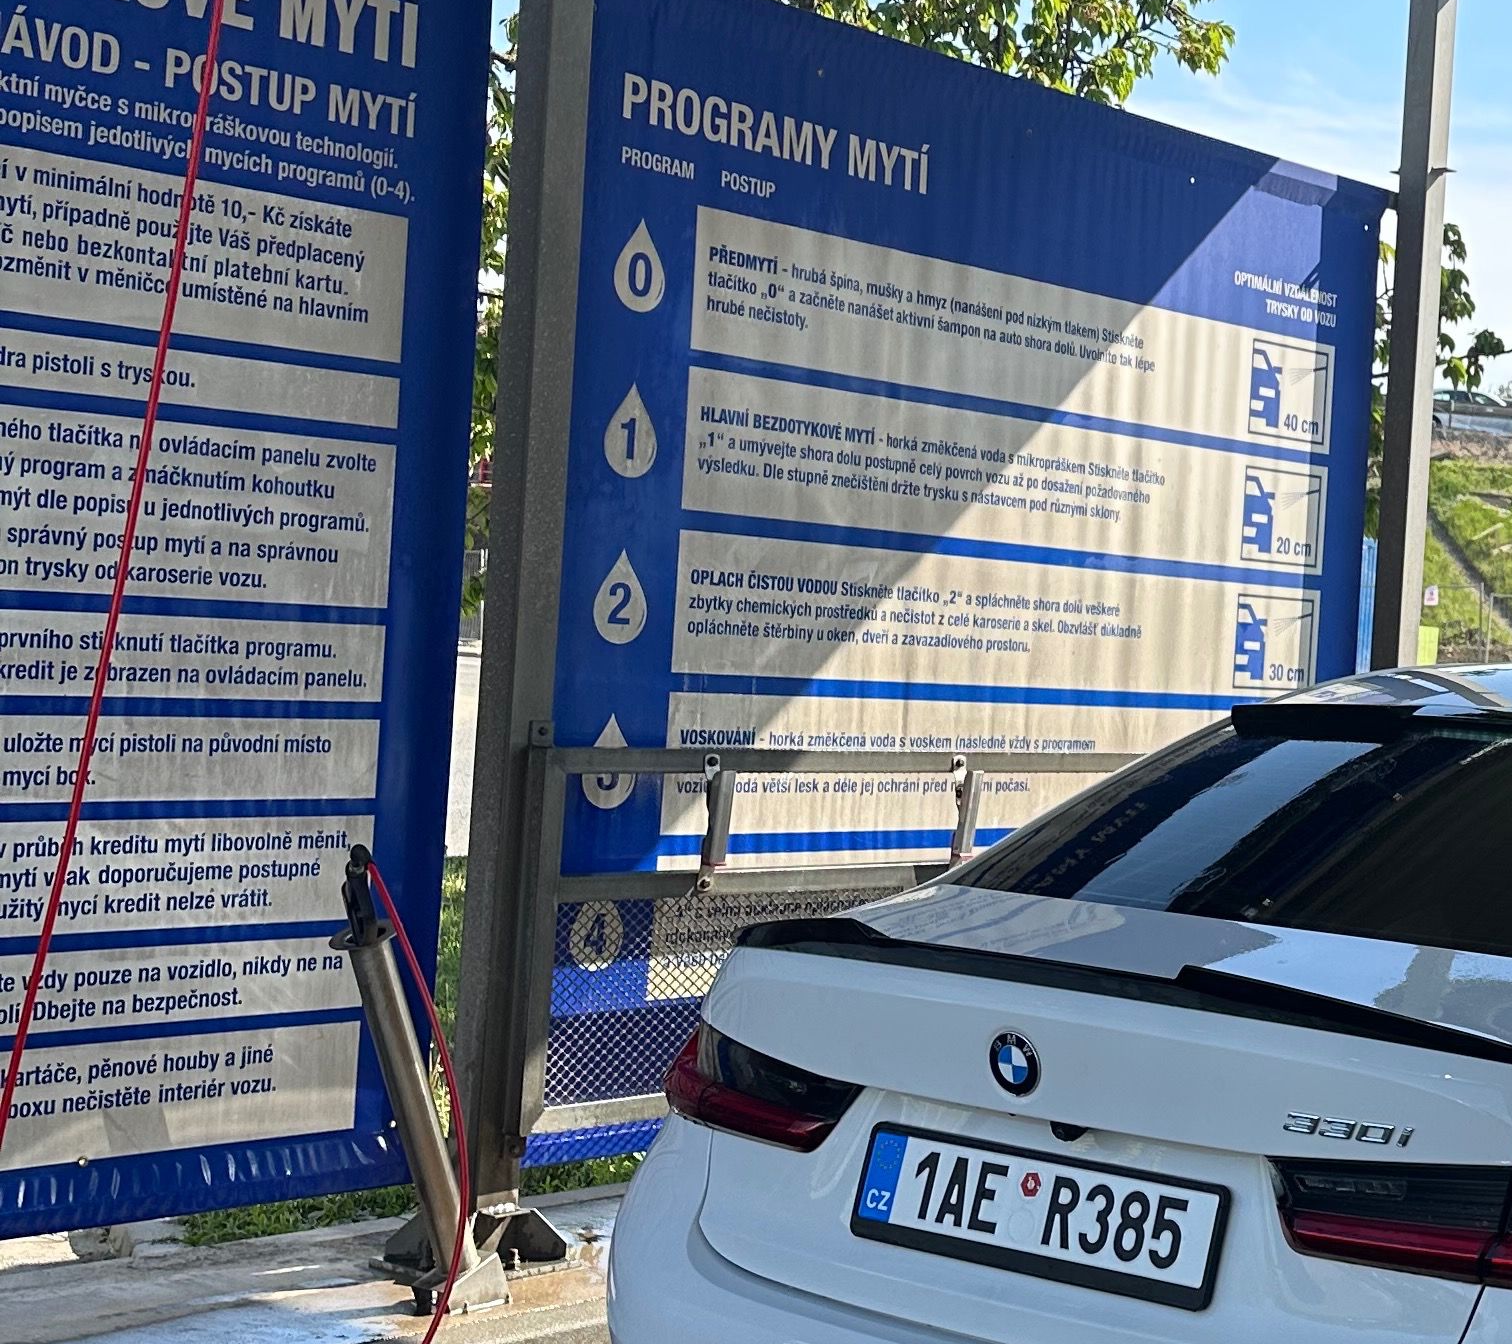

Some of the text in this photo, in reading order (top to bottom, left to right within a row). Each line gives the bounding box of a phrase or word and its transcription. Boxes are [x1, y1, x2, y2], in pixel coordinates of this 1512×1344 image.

[0, 5, 418, 139] ÁVOD POSTUP MYTÍ
[44, 83, 399, 169] myčce mikroráškovou technologií.
[621, 71, 931, 196] PROGRAMY MYTÍ
[205, 145, 365, 192] mycích programů
[621, 145, 776, 199] PROGRAM POSTUP
[34, 167, 132, 201] minimální
[290, 211, 353, 238] získáte
[43, 199, 365, 272] případně použjte Váš předplacený
[23, 229, 289, 287] nebo platební
[627, 252, 653, 299] 0
[182, 279, 369, 324] umístěné na hlavním
[709, 244, 1024, 326] PŘEDMYTÍ hrubá mušky hmyz pod
[1234, 270, 1282, 296] OPTIMÁLNÍ
[706, 294, 809, 332] hrubé nečistoty.
[708, 271, 1051, 353] tlačítko začněte nanášet aktivní šampon auto shora
[1265, 299, 1300, 321] TRYSKY
[32, 351, 94, 376] pistoli
[700, 405, 1006, 464] HLAVNÍ BEZDOTYKOVÉ MYTÍ horká změkčená voda
[1283, 413, 1319, 436] 40 cm
[48, 422, 376, 472] tlačítka ovládacím panelu zvolte
[739, 438, 1010, 486] umývejte shora povrch vozu
[20, 457, 335, 499] program kohoutku
[698, 454, 959, 502] výsledku. Dle držte trysku
[37, 488, 274, 527] dle jednotlivých
[7, 523, 338, 564] správný posup mytí na správnou
[1276, 537, 1312, 557] 20 cm
[25, 559, 267, 589] trysky vozu.
[690, 568, 1060, 613] OPLACH ČISTOU VODOU Stiskněte tlačítko shora
[607, 582, 632, 626] 2
[688, 594, 877, 623] zbytky chemických prostředků
[79, 631, 336, 661] stiknutí tlačítka programu.
[687, 617, 813, 643] opláchněte štěrbiny
[59, 662, 367, 690] je zbrazen na ovládacím panelu.
[1268, 663, 1305, 683] 30 cm
[4, 731, 332, 757] uložte pistoli na původní místo
[680, 726, 952, 749] VOSKOVÁNÍ horká změkčená voda voskem
[3, 765, 51, 790] mycí
[794, 778, 948, 795] lesk před
[91, 835, 158, 856] kreditu
[164, 832, 206, 857] mytí
[211, 830, 293, 852] libovolně
[98, 857, 321, 888] doporučujeme postupné
[104, 892, 161, 914] kredit
[74, 955, 343, 992] pouze na vozidlo, nikdy ne na
[33, 986, 243, 1023] Dbejte na bezpečnost.
[87, 1043, 274, 1084] pěnové houby jiné
[993, 1033, 1033, 1057] BMW
[62, 1077, 277, 1116] nečistěte interiér vozu.
[1282, 1110, 1416, 1149] 330i
[866, 1187, 892, 1213] CZ
[914, 1150, 1190, 1270] 1AE R385
